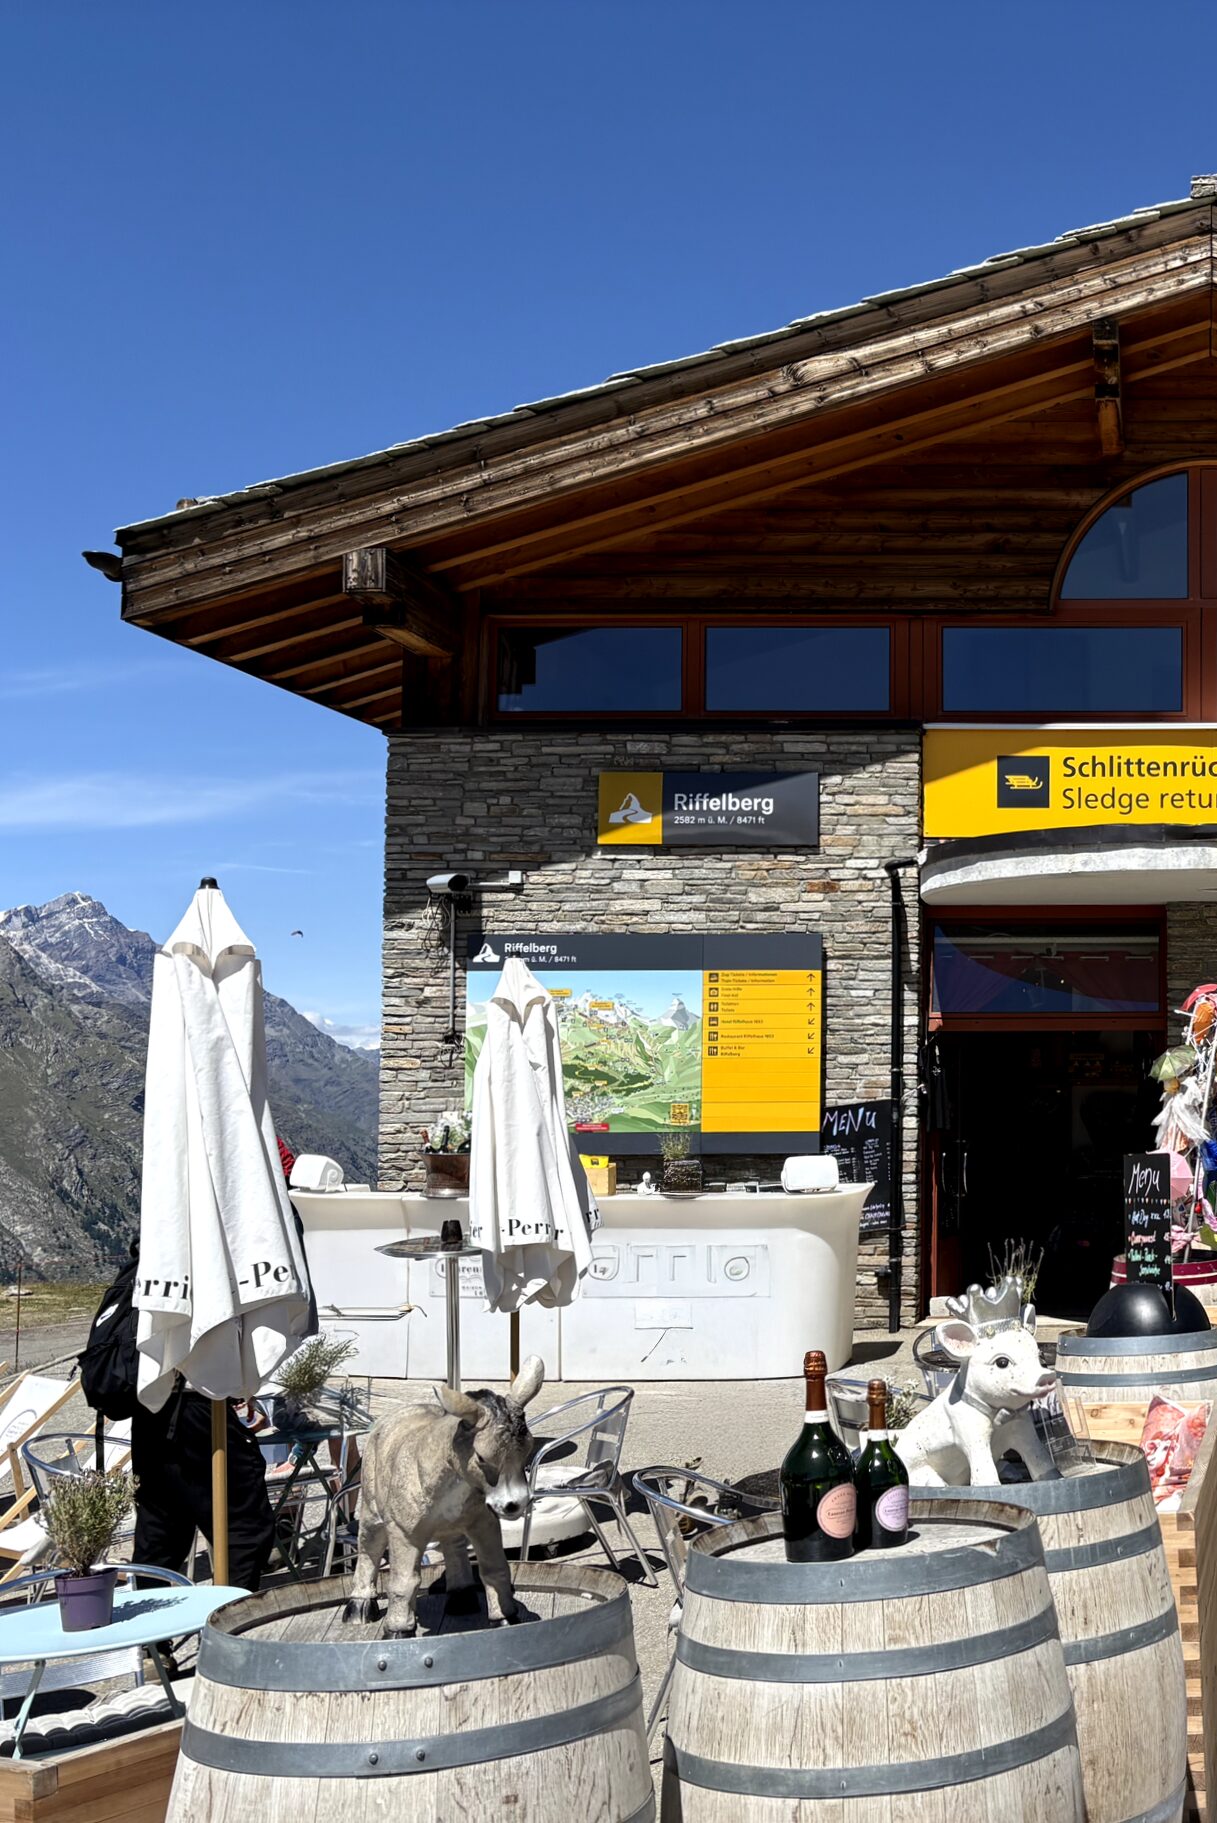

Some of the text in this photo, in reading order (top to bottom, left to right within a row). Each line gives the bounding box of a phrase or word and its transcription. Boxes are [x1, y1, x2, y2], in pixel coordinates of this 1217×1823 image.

[673, 792, 775, 816] Riffelberg
[1062, 786, 1150, 816] Sledge
[673, 815, 696, 825] 2582
[697, 817, 706, 825] m
[717, 815, 729, 825] M.
[736, 815, 757, 825] 8471
[757, 815, 766, 825] ft
[504, 942, 558, 955] Riffelberg
[1127, 1161, 1161, 1197] Menu
